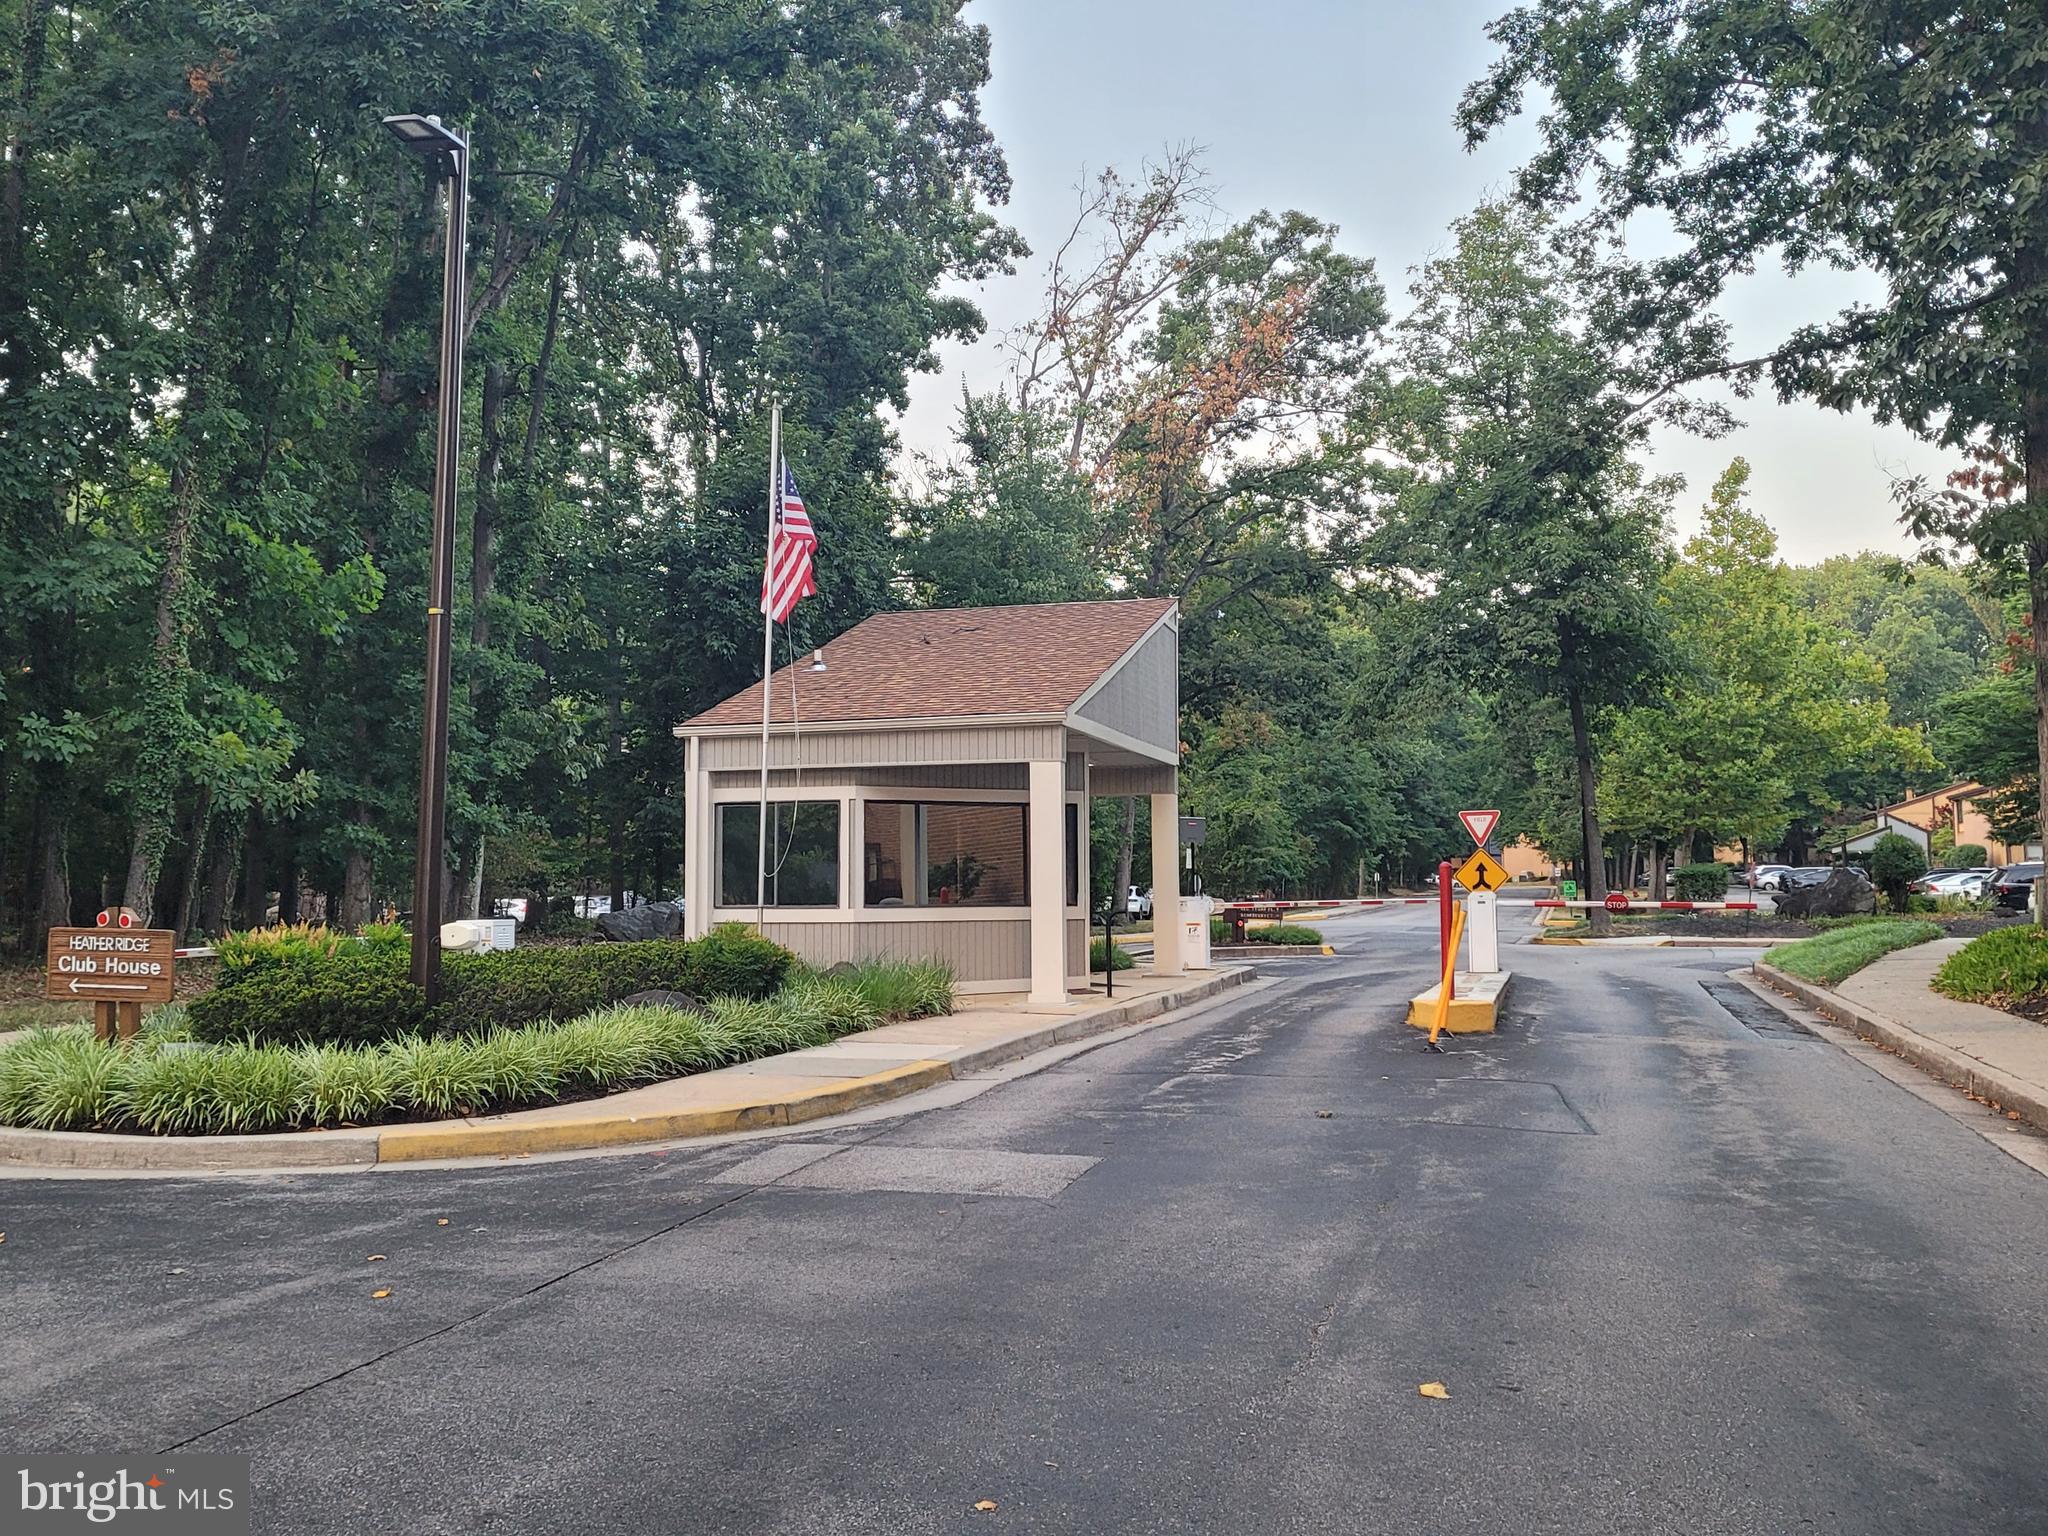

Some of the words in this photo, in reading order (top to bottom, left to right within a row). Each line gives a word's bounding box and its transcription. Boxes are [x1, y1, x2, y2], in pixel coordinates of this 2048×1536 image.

[1607, 901, 1627, 909] STOP
[69, 936, 114, 951] HEATHER
[115, 937, 151, 952] RIDGE
[58, 955, 97, 973] Club
[105, 957, 161, 975] House
